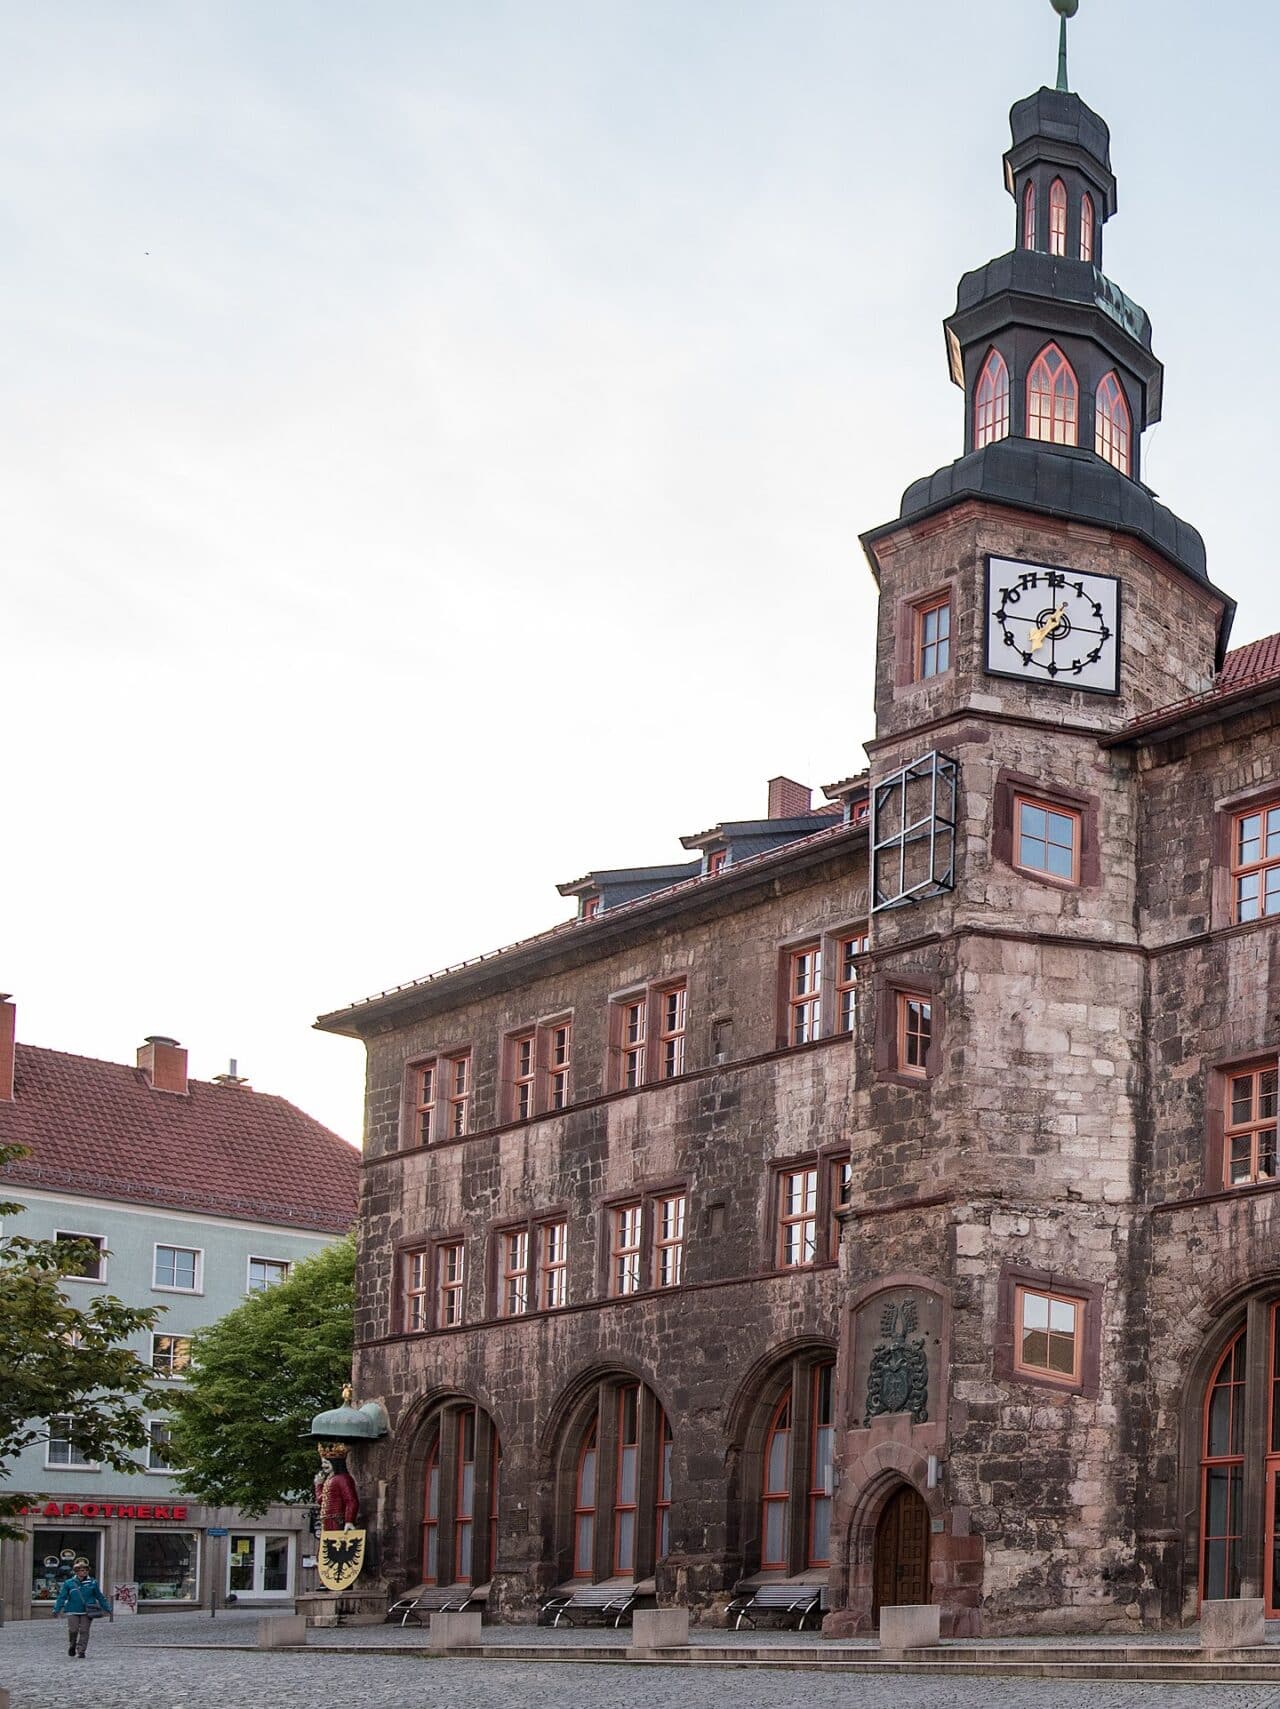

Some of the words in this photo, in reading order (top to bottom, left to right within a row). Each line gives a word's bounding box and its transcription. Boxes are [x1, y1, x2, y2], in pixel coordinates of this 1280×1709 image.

[1018, 572, 1038, 590] 11
[1044, 571, 1065, 589] 12
[998, 588, 1021, 604] 10
[1074, 582, 1084, 598] 1
[1091, 602, 1102, 617] 2
[1003, 631, 1015, 647] 8
[1100, 626, 1110, 642] 3
[1022, 650, 1033, 667] 7
[1087, 648, 1101, 663] 4
[1072, 659, 1082, 675] 5
